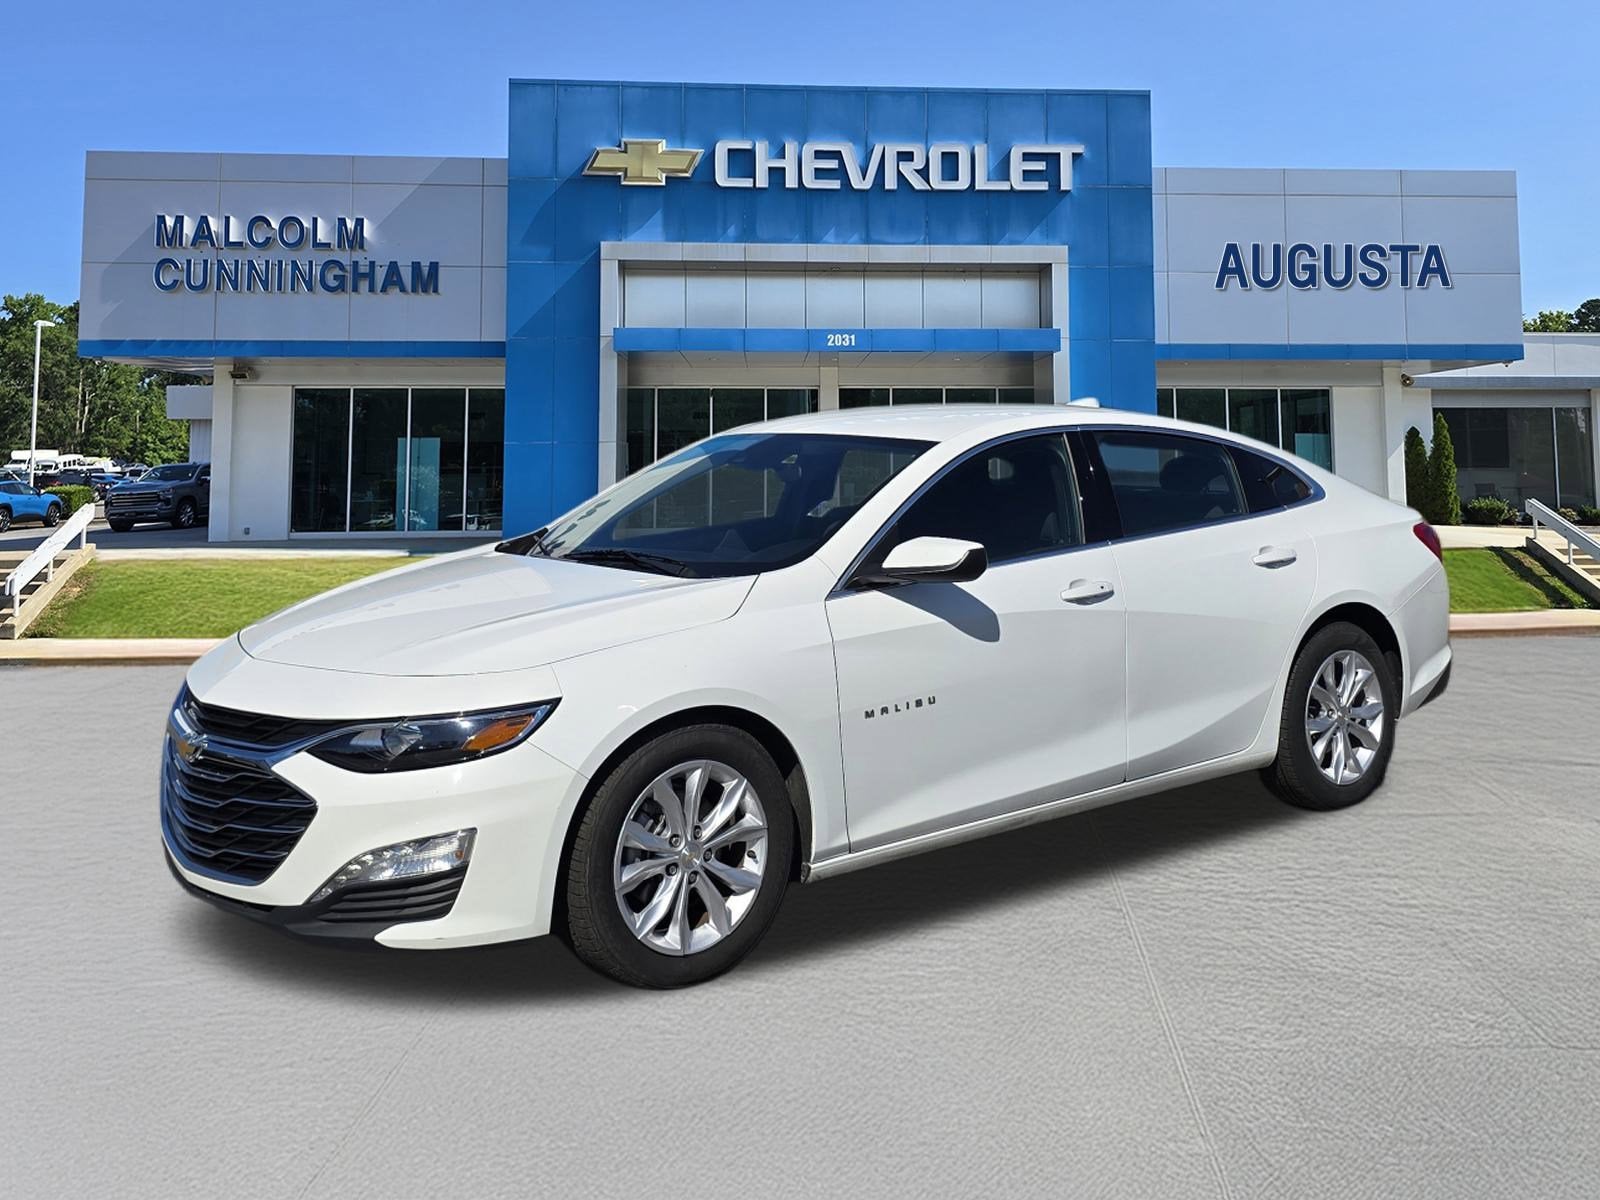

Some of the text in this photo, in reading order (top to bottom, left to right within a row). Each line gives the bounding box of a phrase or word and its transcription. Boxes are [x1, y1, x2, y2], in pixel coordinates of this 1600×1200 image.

[714, 140, 1085, 191] CHEVROLET
[154, 214, 366, 250] MALCOLM
[153, 257, 440, 294] CUNNINGHAM
[1214, 242, 1452, 290] AUGUSTA
[827, 333, 856, 347] 2031
[864, 695, 936, 720] MALIBU
